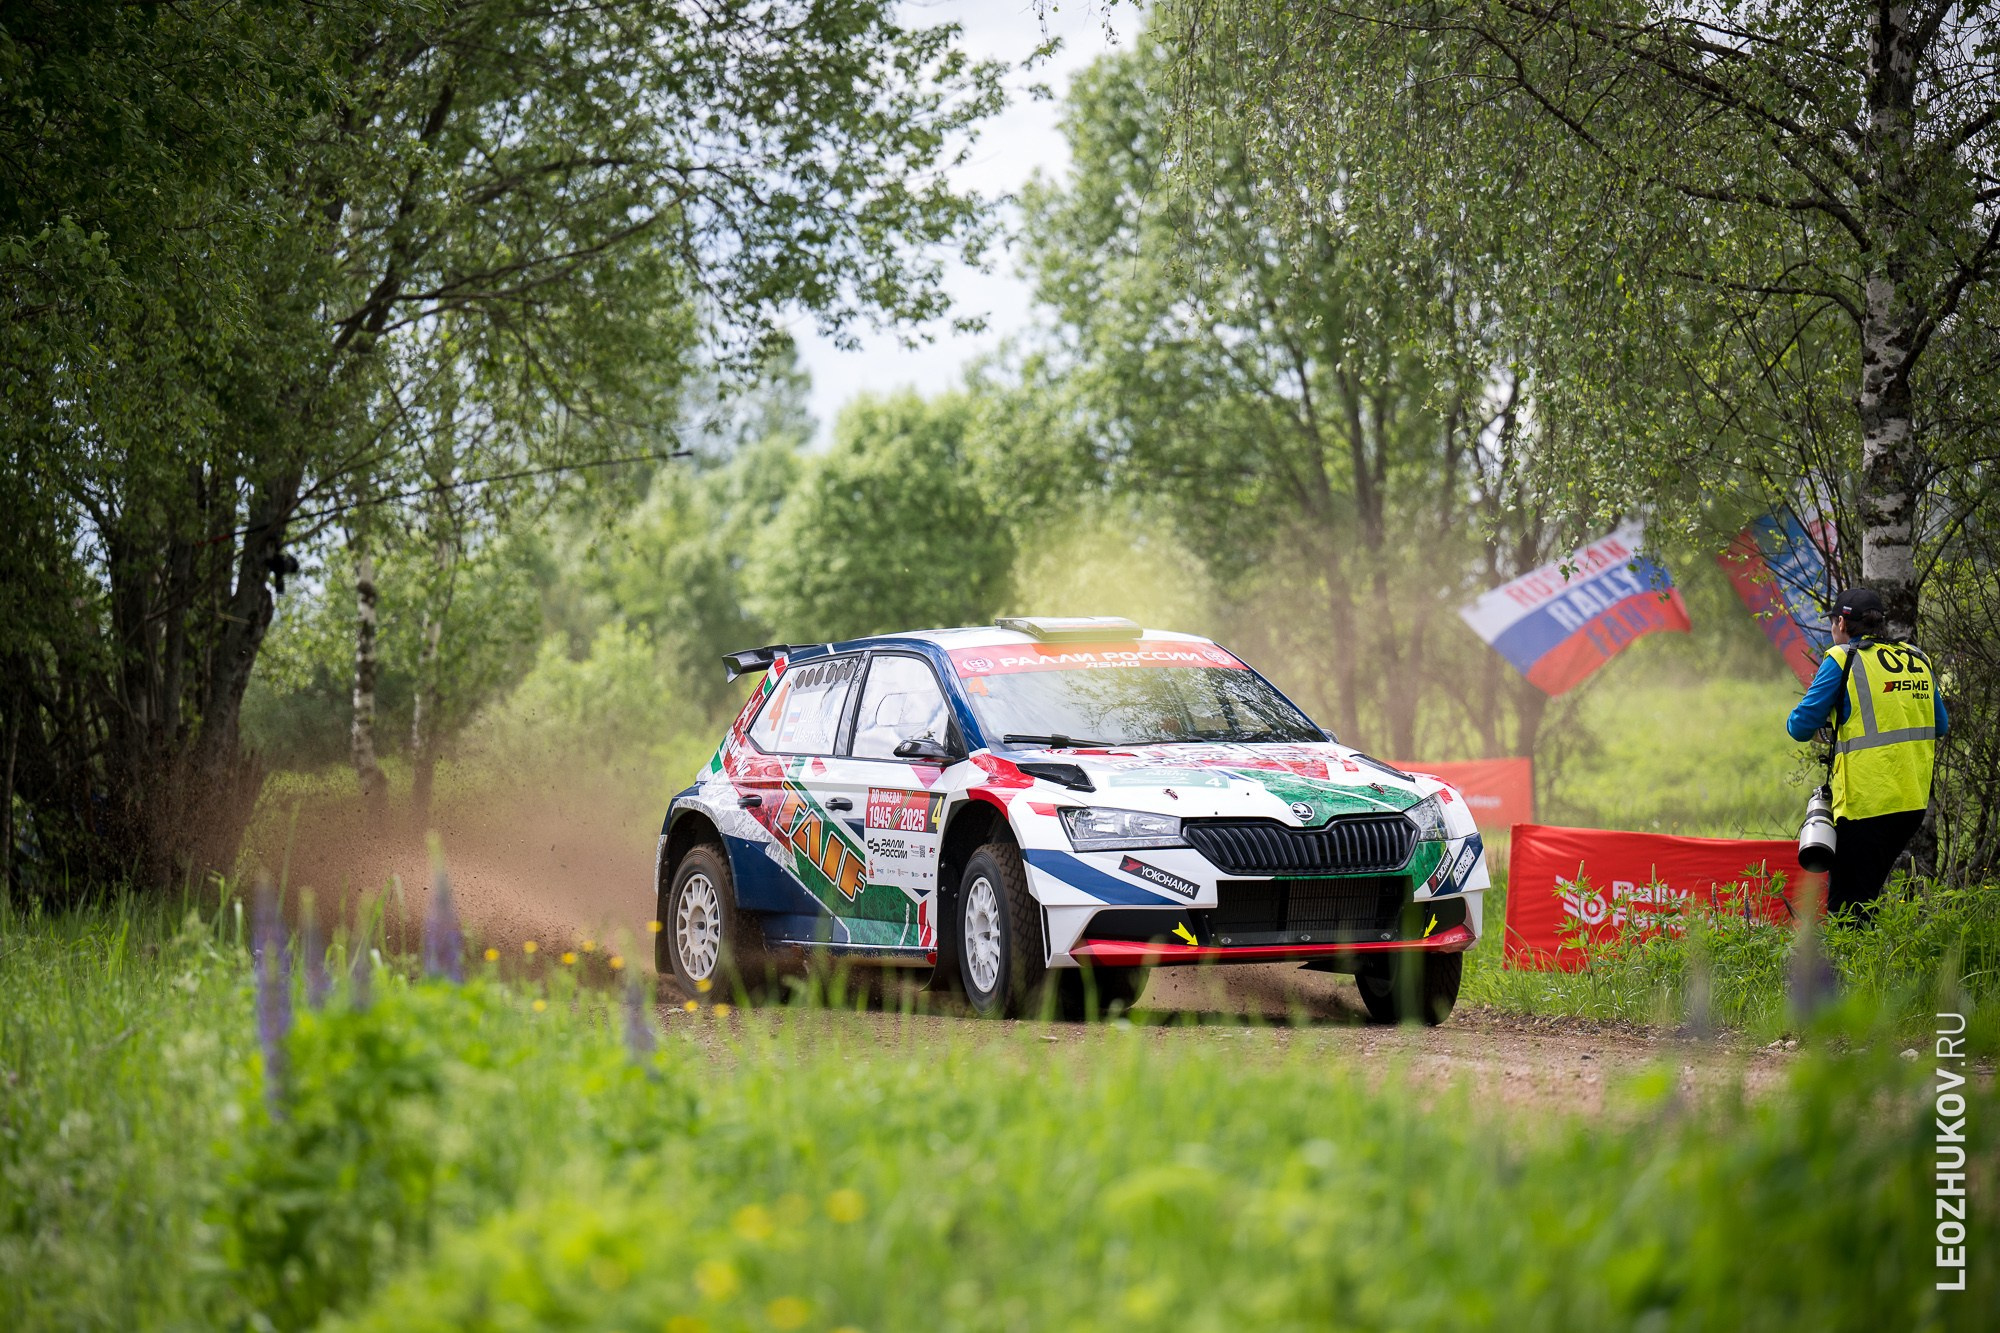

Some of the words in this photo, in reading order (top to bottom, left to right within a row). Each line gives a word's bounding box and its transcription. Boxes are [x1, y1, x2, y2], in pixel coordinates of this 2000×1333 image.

[1546, 567, 1644, 633] RALLY
[1000, 651, 1096, 668] РАЛЛИ
[1103, 650, 1203, 663] РОССИИ
[1085, 660, 1141, 669] ASMG
[967, 677, 989, 697] 4
[1886, 680, 1929, 692] ASMG
[769, 681, 791, 732] 4
[1205, 777, 1222, 787] 4
[870, 789, 879, 804] 80
[869, 805, 892, 829] 1945
[901, 807, 925, 831] 2025
[931, 796, 943, 831] 4
[775, 780, 867, 902] TAIF
[881, 838, 905, 849] РАЛЛИ
[880, 848, 908, 859] РОССИИ
[1141, 865, 1194, 896] YOKOHAMA
[1612, 880, 1688, 908] Rally
